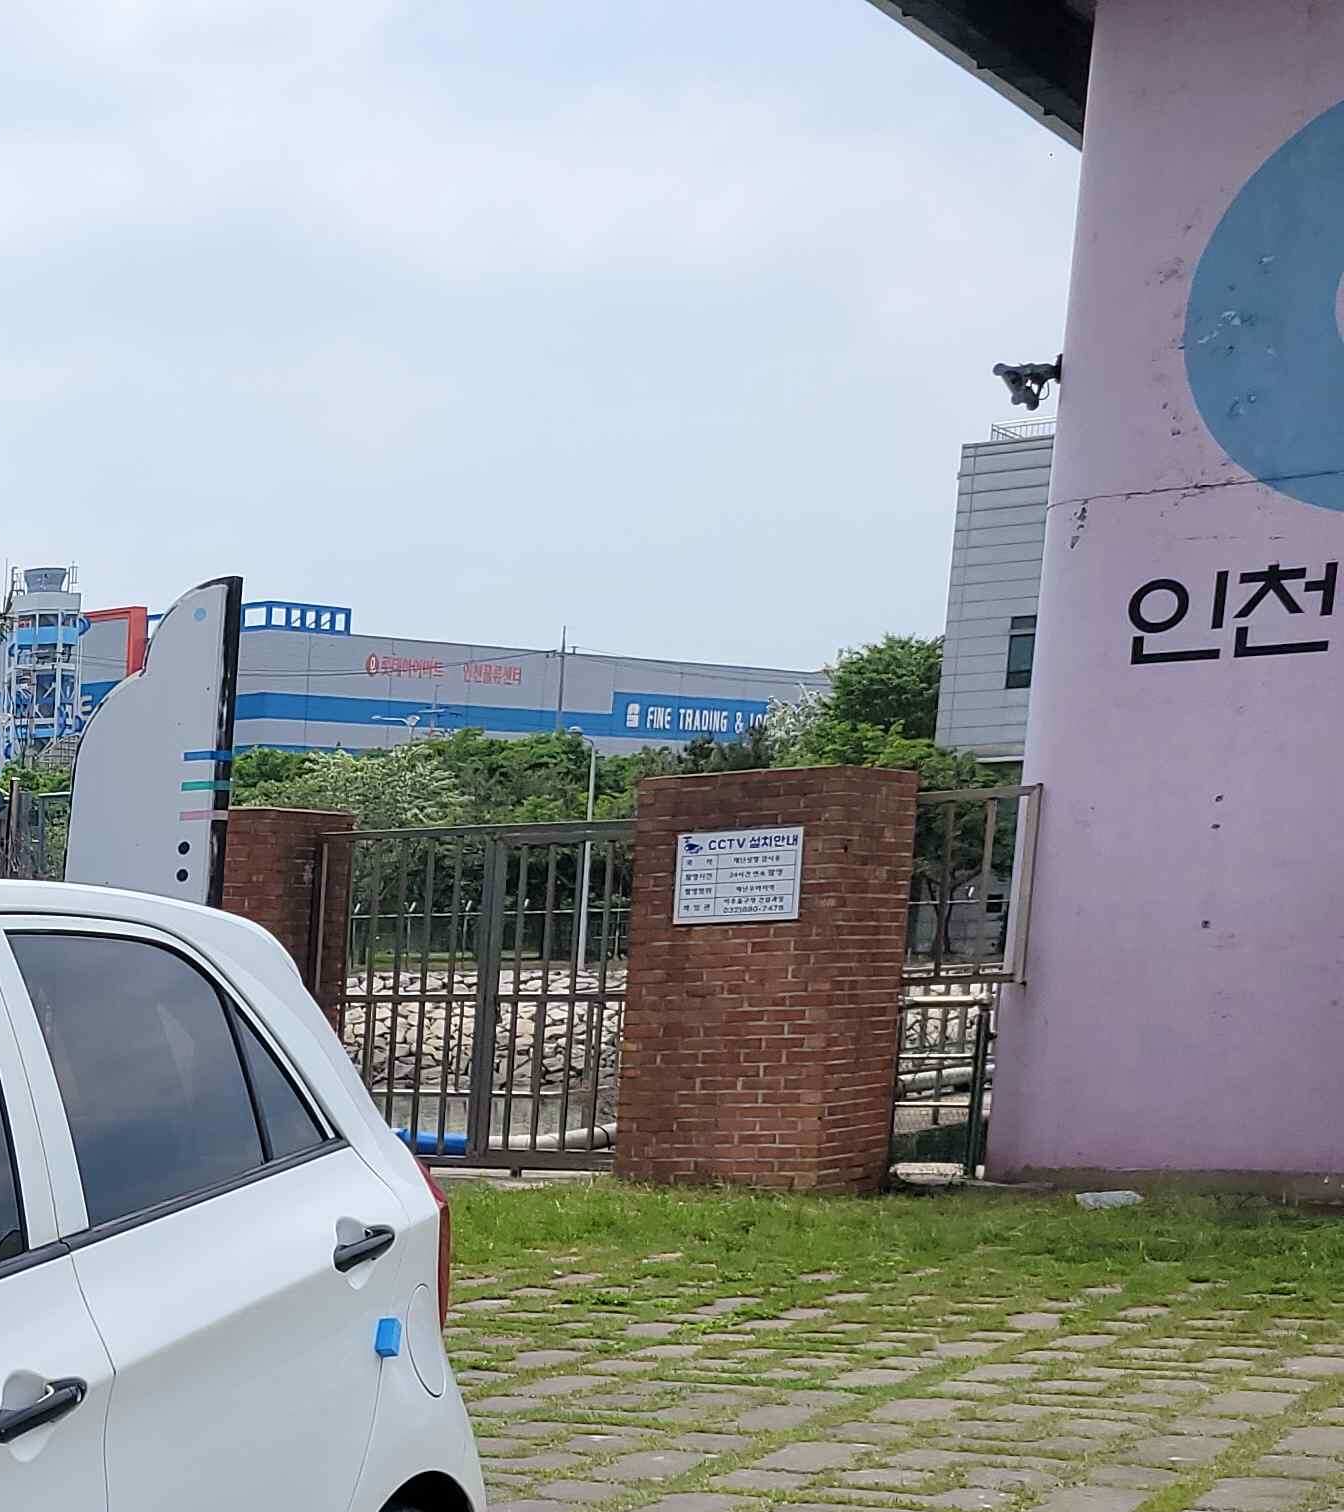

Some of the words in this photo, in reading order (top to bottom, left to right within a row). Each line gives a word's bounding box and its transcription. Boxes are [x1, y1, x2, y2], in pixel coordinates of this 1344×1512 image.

[1127, 560, 1339, 666] 인천
[646, 706, 673, 729] FINE
[679, 708, 728, 732] TRADING
[734, 711, 744, 734] &
[708, 838, 746, 851] CCTV
[749, 834, 799, 849] 설치안내
